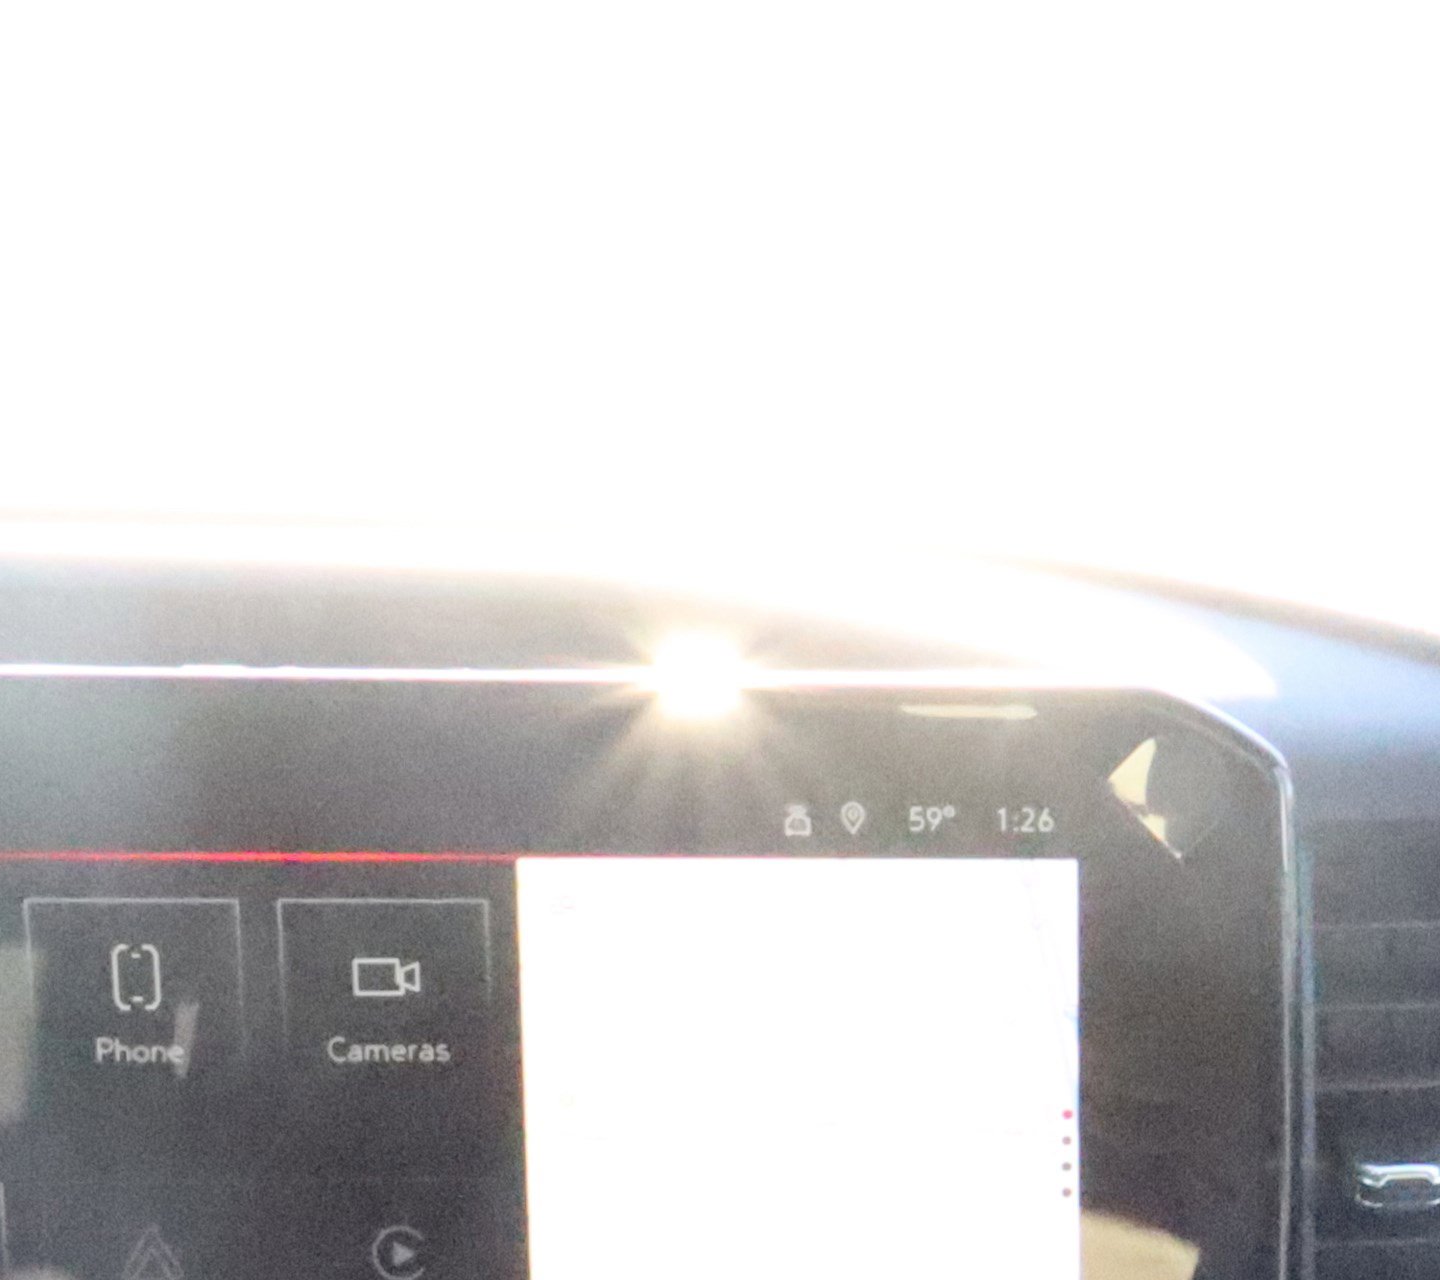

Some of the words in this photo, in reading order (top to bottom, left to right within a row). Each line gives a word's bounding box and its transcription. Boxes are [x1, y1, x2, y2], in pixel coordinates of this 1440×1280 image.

[997, 807, 1055, 833] 1:26
[95, 1037, 185, 1065] Phone
[327, 1037, 452, 1065] Cameras
